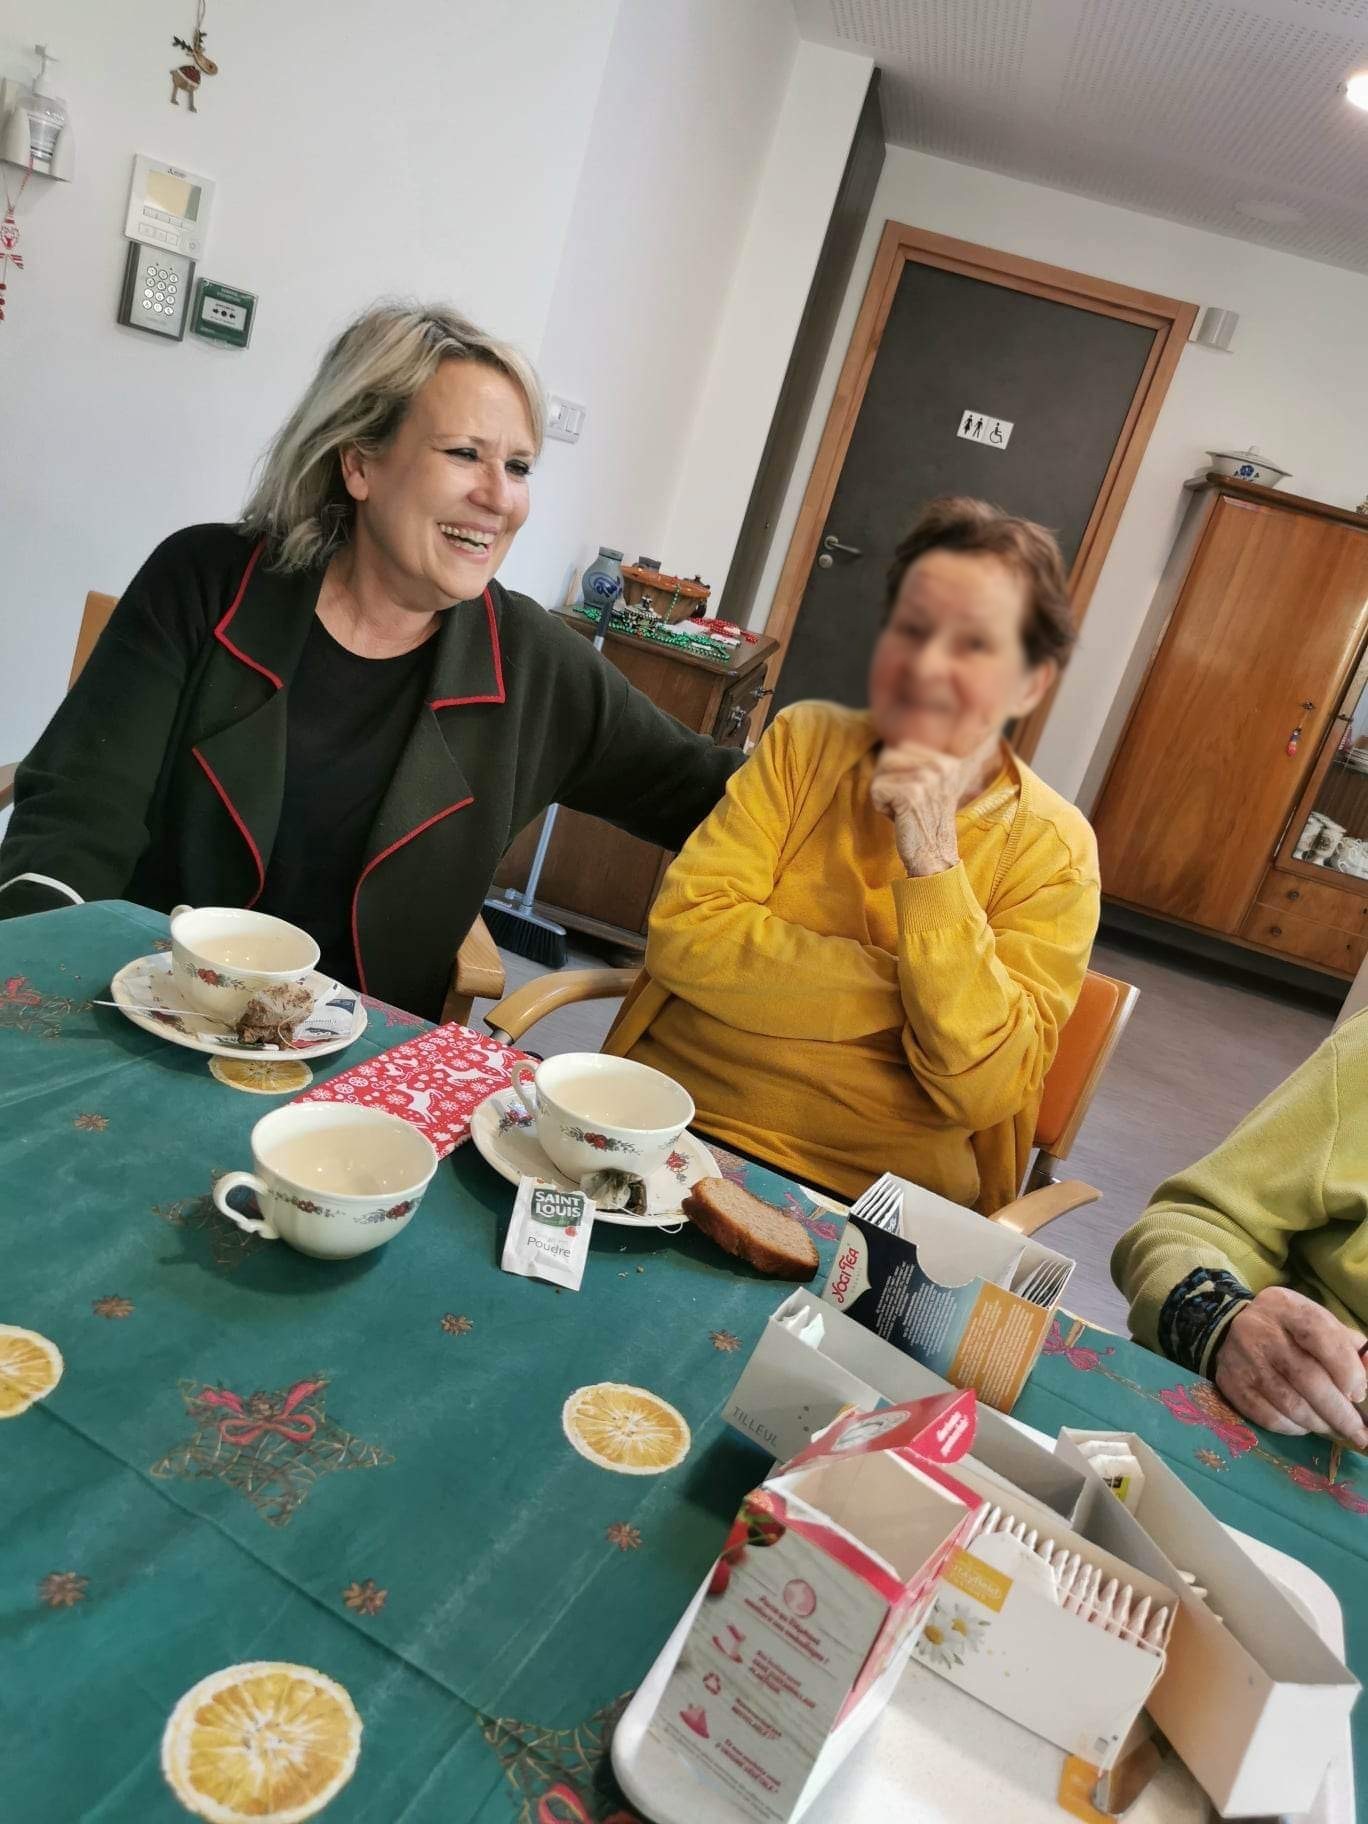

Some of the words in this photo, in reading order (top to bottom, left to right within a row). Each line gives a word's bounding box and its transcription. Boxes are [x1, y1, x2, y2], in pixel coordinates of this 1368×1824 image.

[535, 1191, 581, 1206] SAINT
[535, 1202, 581, 1218] LOUIS
[527, 1236, 572, 1258] Poudre
[838, 1247, 859, 1270] TEA
[831, 1270, 852, 1303] YOGI
[733, 1406, 778, 1447] TILLEUL
